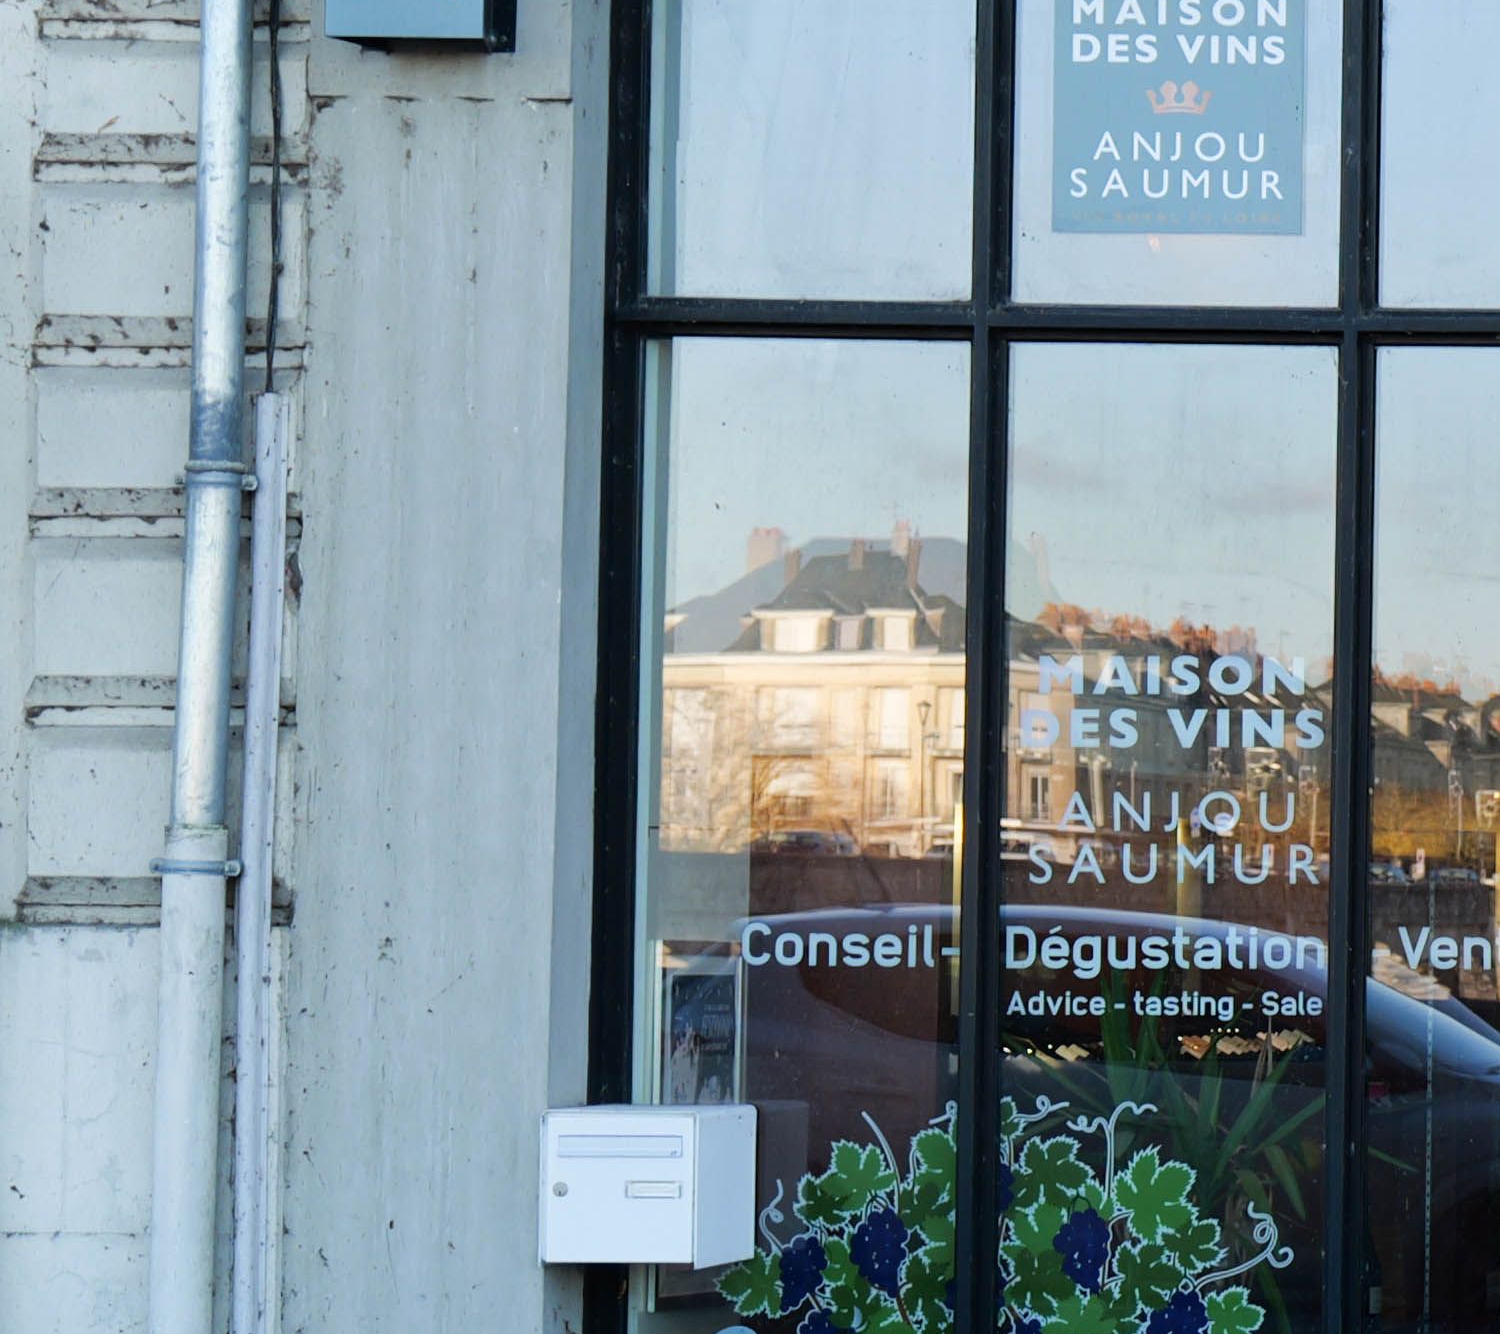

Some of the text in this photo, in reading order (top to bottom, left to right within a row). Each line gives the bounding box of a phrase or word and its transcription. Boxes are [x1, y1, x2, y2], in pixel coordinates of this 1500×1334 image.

[1072, 34, 1286, 65] DES VINS
[1093, 131, 1266, 163] ANJOU
[1070, 168, 1285, 201] SAUMUR
[1038, 655, 1305, 695] MAISON
[1020, 708, 1325, 749] DES VINS
[1057, 791, 1295, 833] ANJOU
[1028, 842, 1320, 885] SAUMUR
[1005, 925, 1325, 980] Dégustation
[1006, 990, 1106, 1016] Advice
[1134, 990, 1234, 1021] tasting
[1261, 991, 1323, 1016] Sale
